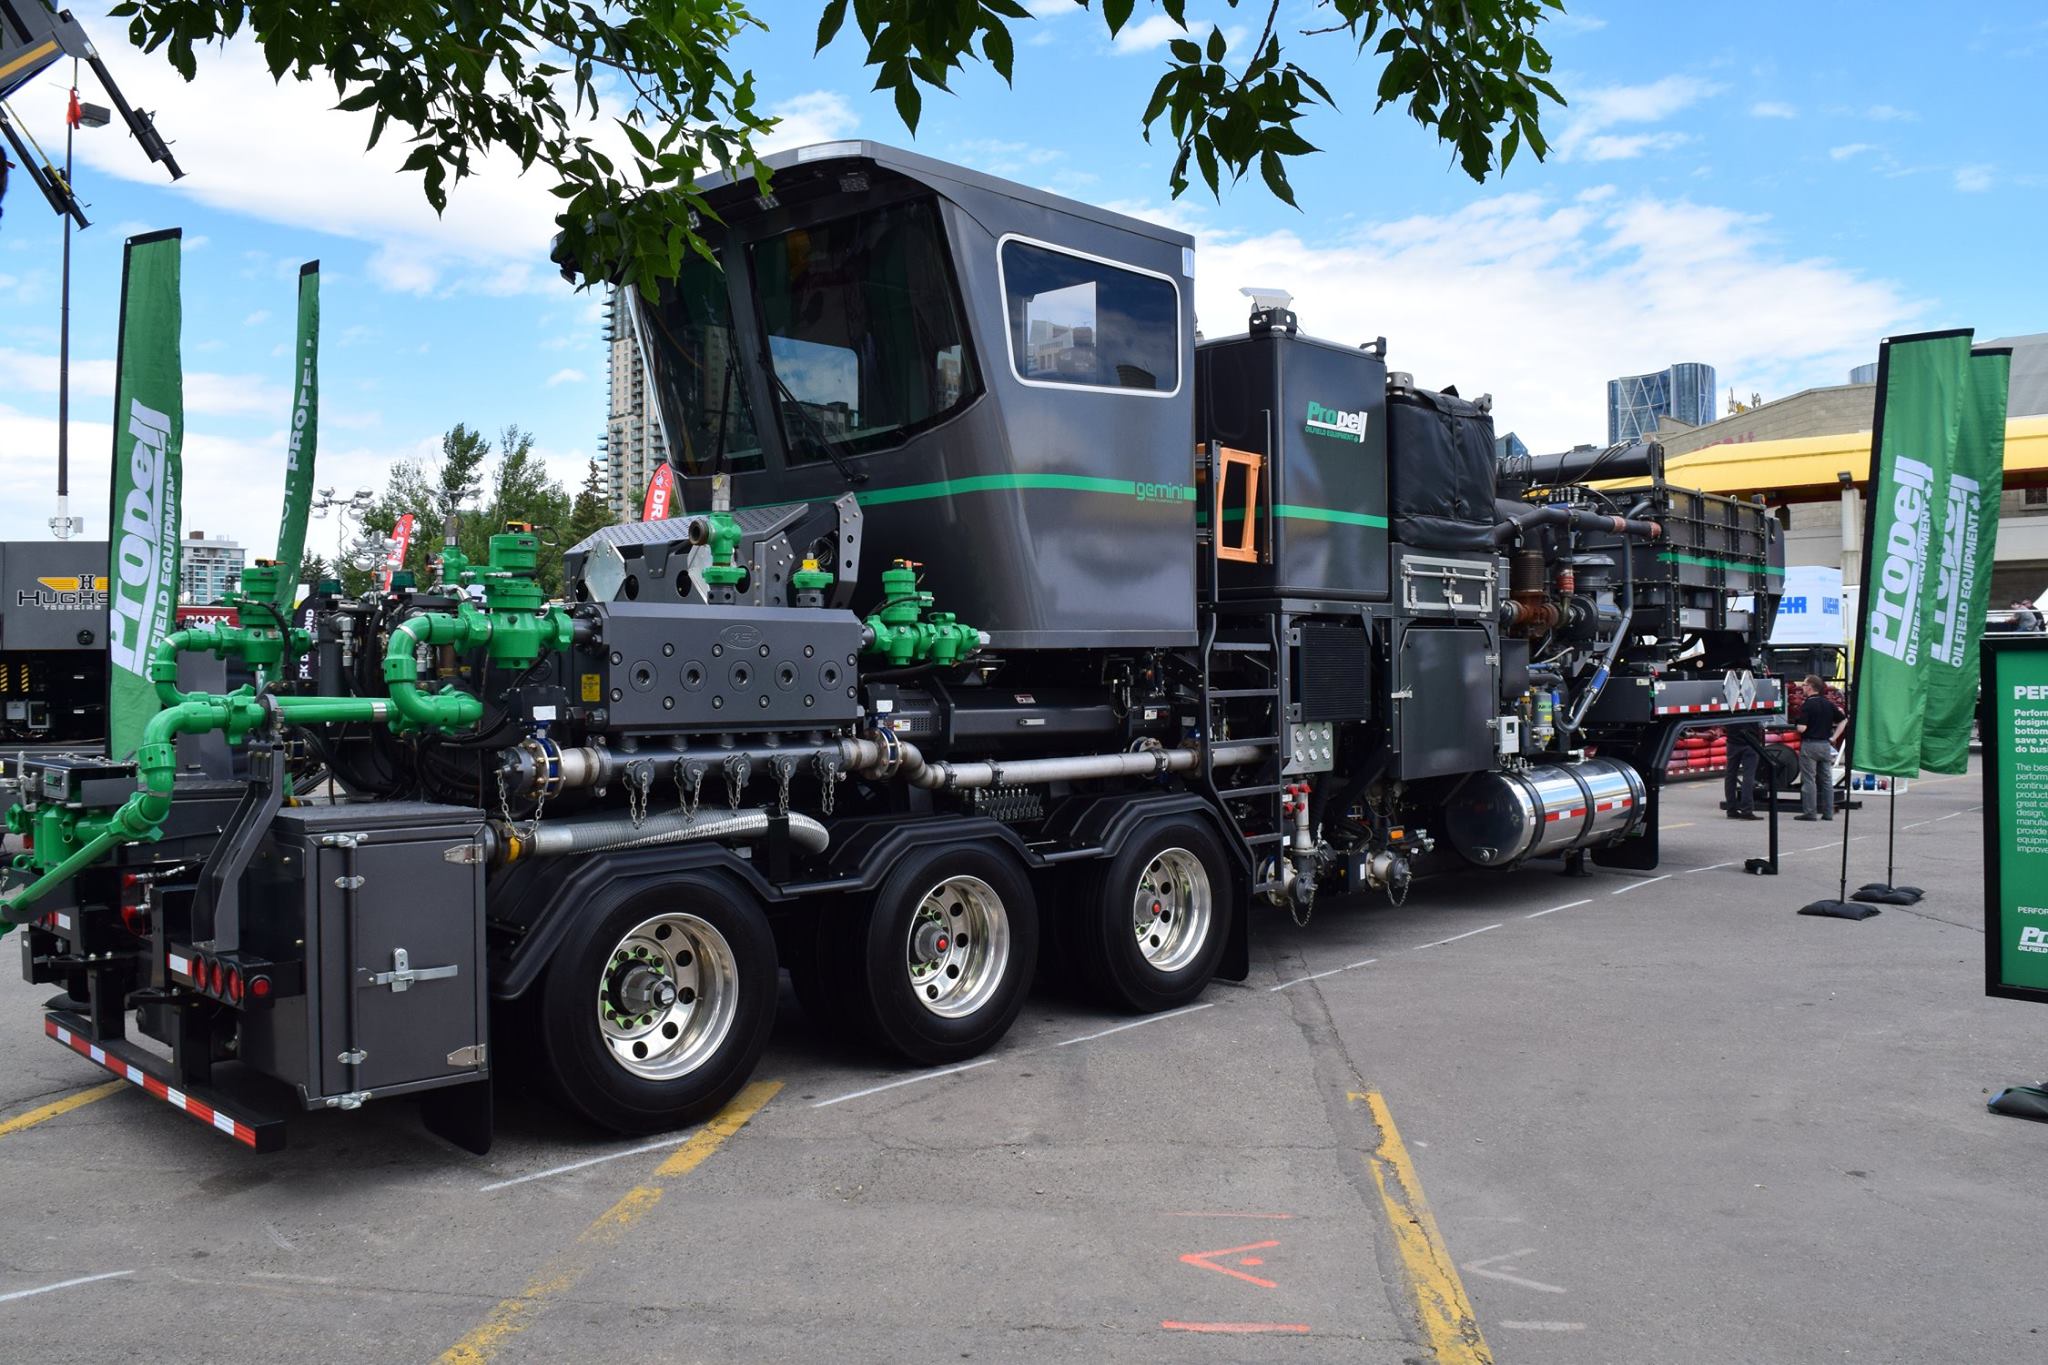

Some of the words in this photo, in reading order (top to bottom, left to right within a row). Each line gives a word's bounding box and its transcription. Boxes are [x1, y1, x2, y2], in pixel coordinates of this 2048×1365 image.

[1306, 400, 1368, 443] Propell
[110, 397, 171, 676] Propell
[1136, 482, 1183, 501] gemini
[1871, 455, 1933, 661] Propell
[1951, 602, 1969, 668] OILFIELD
[1960, 511, 1979, 599] EQUIPMENT
[2015, 745, 2027, 753] do
